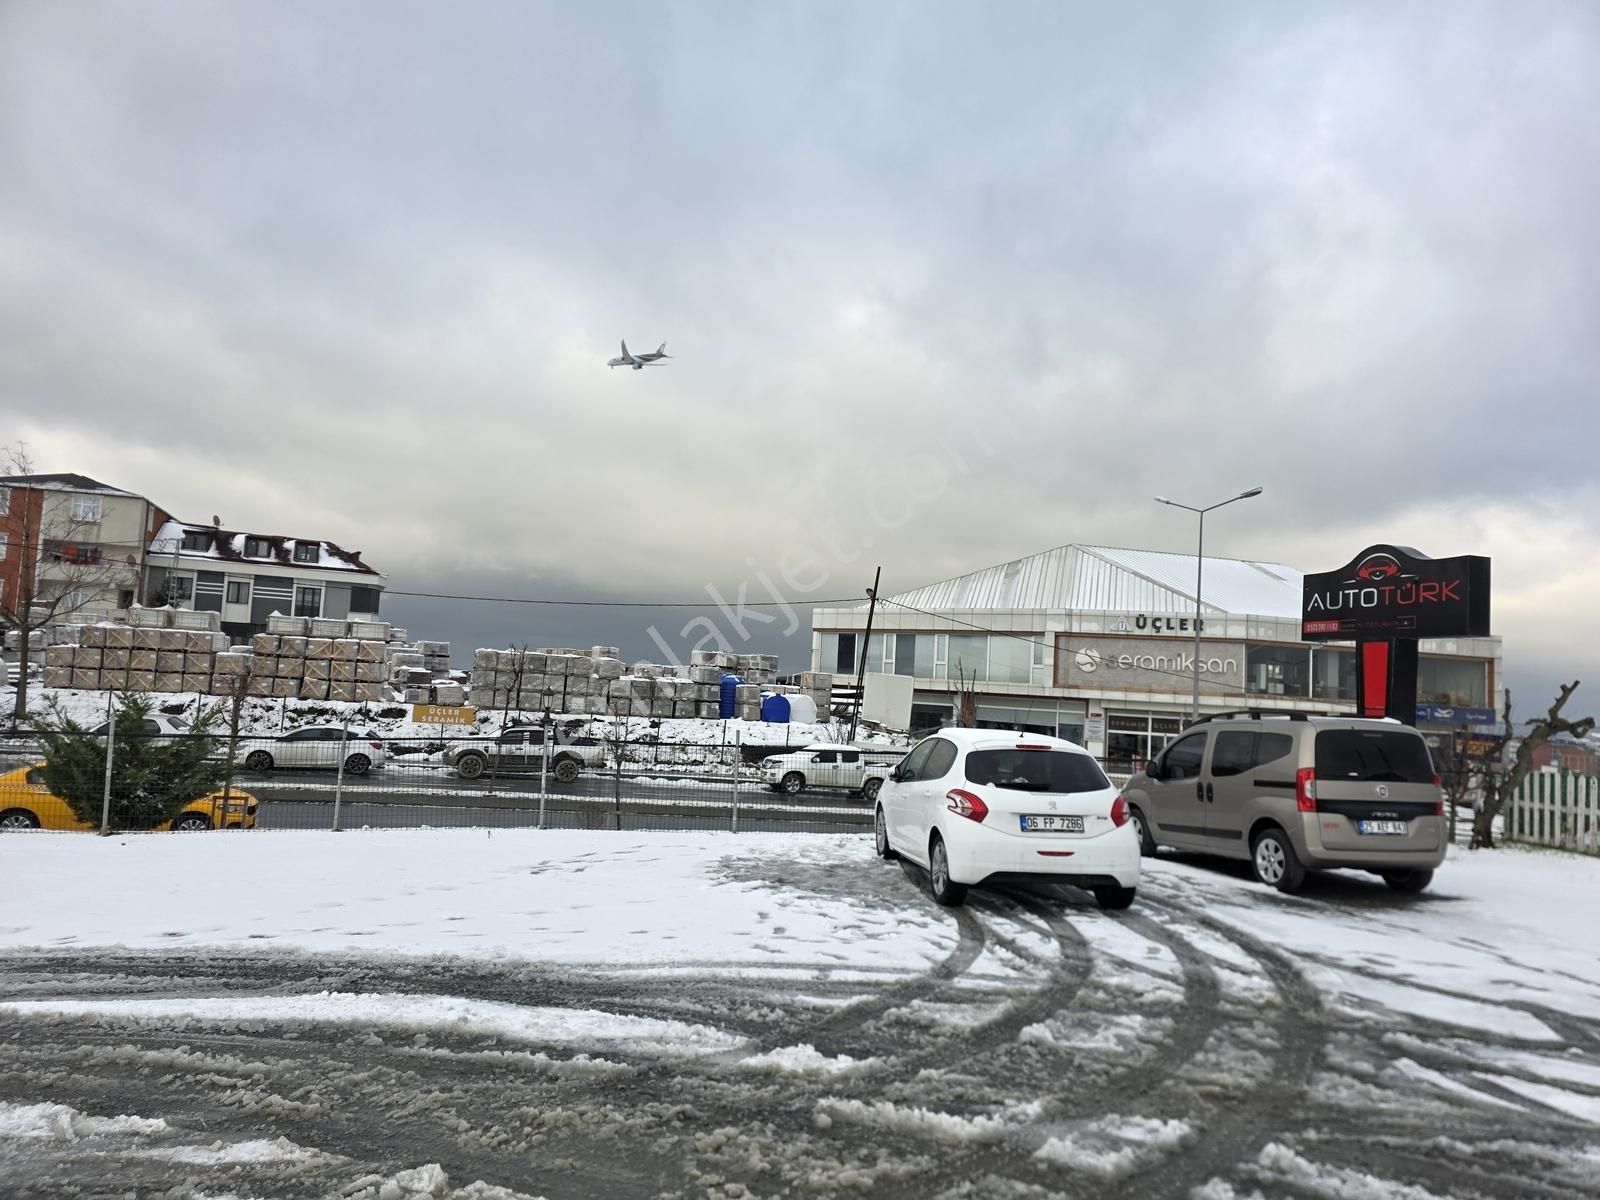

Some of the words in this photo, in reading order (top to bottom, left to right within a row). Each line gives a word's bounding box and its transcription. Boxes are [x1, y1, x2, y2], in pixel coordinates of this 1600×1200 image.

[429, 707, 460, 715] ÜÇLER
[1027, 817, 1038, 828] 06
[1043, 817, 1055, 828] FP
[1060, 818, 1082, 829] 7286
